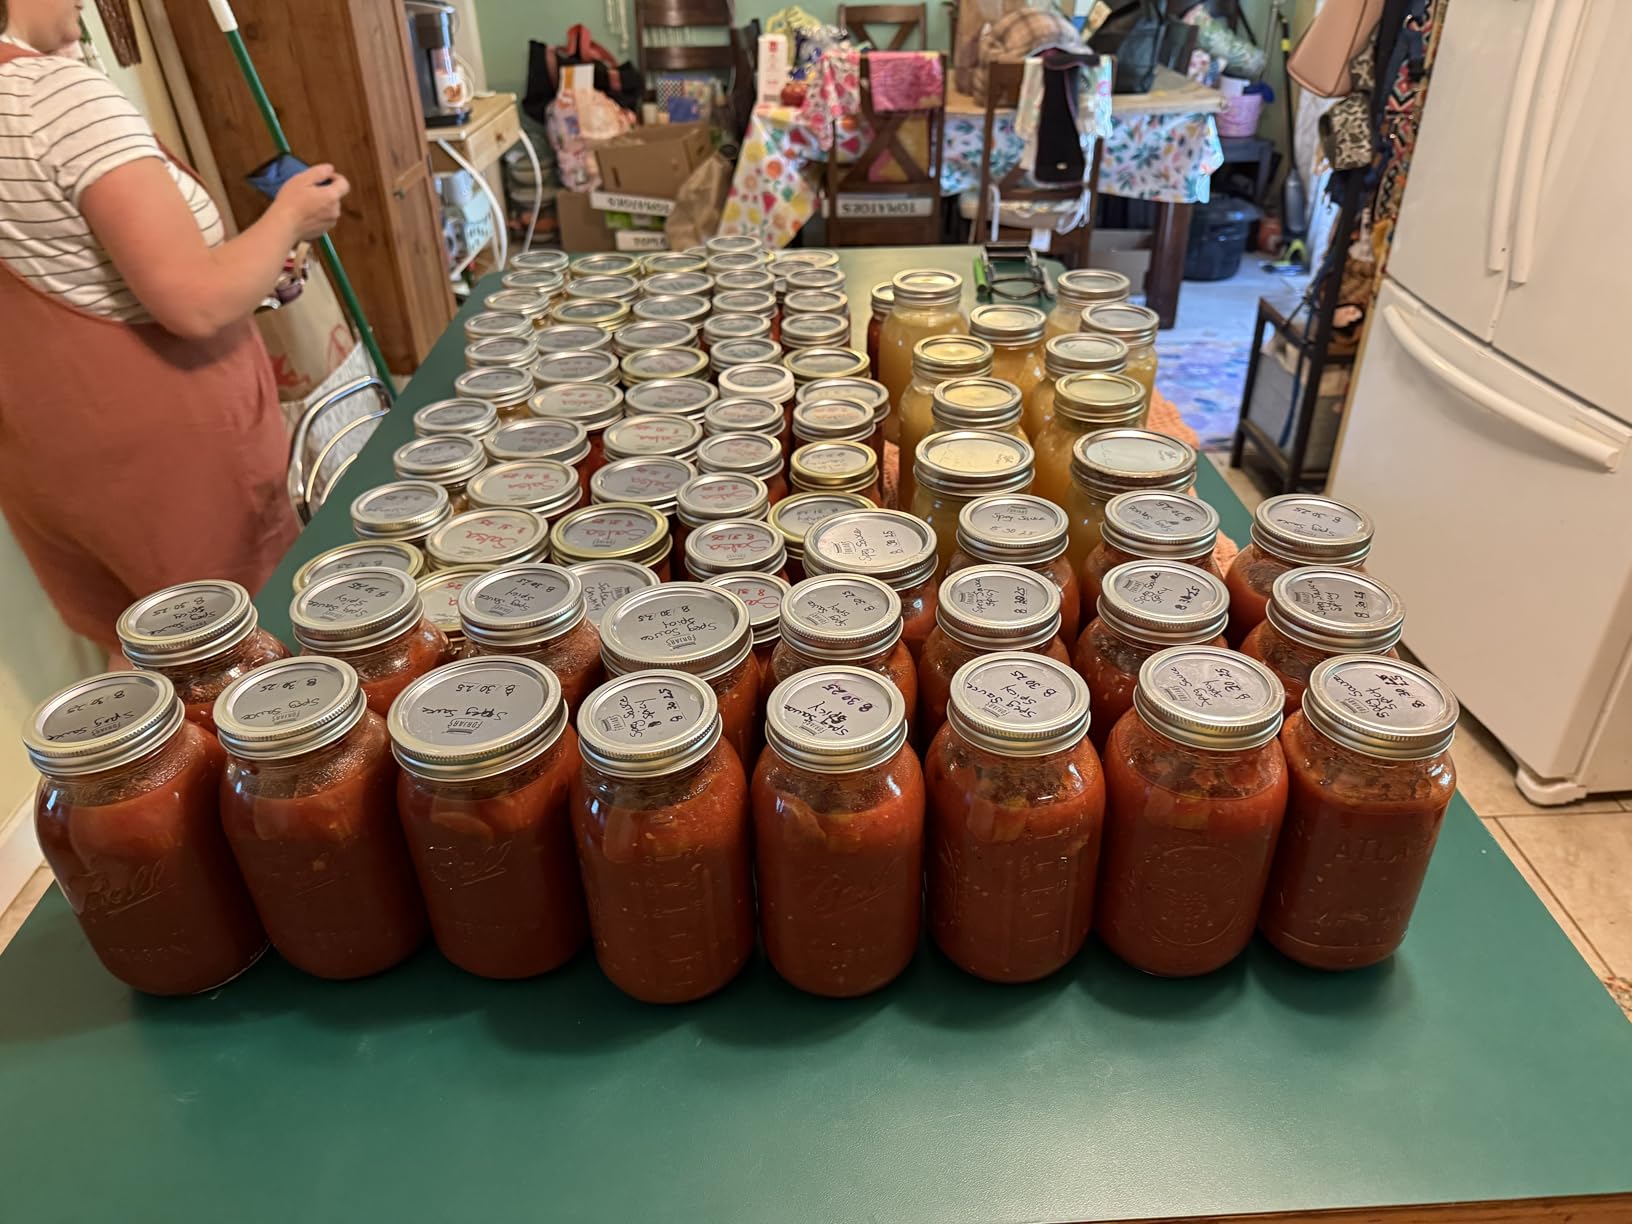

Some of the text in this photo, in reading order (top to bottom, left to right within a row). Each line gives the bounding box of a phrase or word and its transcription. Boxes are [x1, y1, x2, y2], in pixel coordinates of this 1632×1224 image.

[706, 540, 770, 552] Salsa
[261, 679, 317, 692] 8 30 25
[456, 684, 516, 696] 8 30 25
[1010, 670, 1057, 698] 8 30 25
[1215, 668, 1250, 701] 8 30 25
[114, 689, 126, 700] 8
[822, 683, 873, 712] 8 30 25
[1000, 685, 1037, 705] Spicy
[1394, 688, 1411, 697] 30
[666, 701, 677, 711] 30
[1411, 700, 1425, 709] 8
[448, 720, 483, 730] FORJARS
[669, 715, 684, 723] 8
